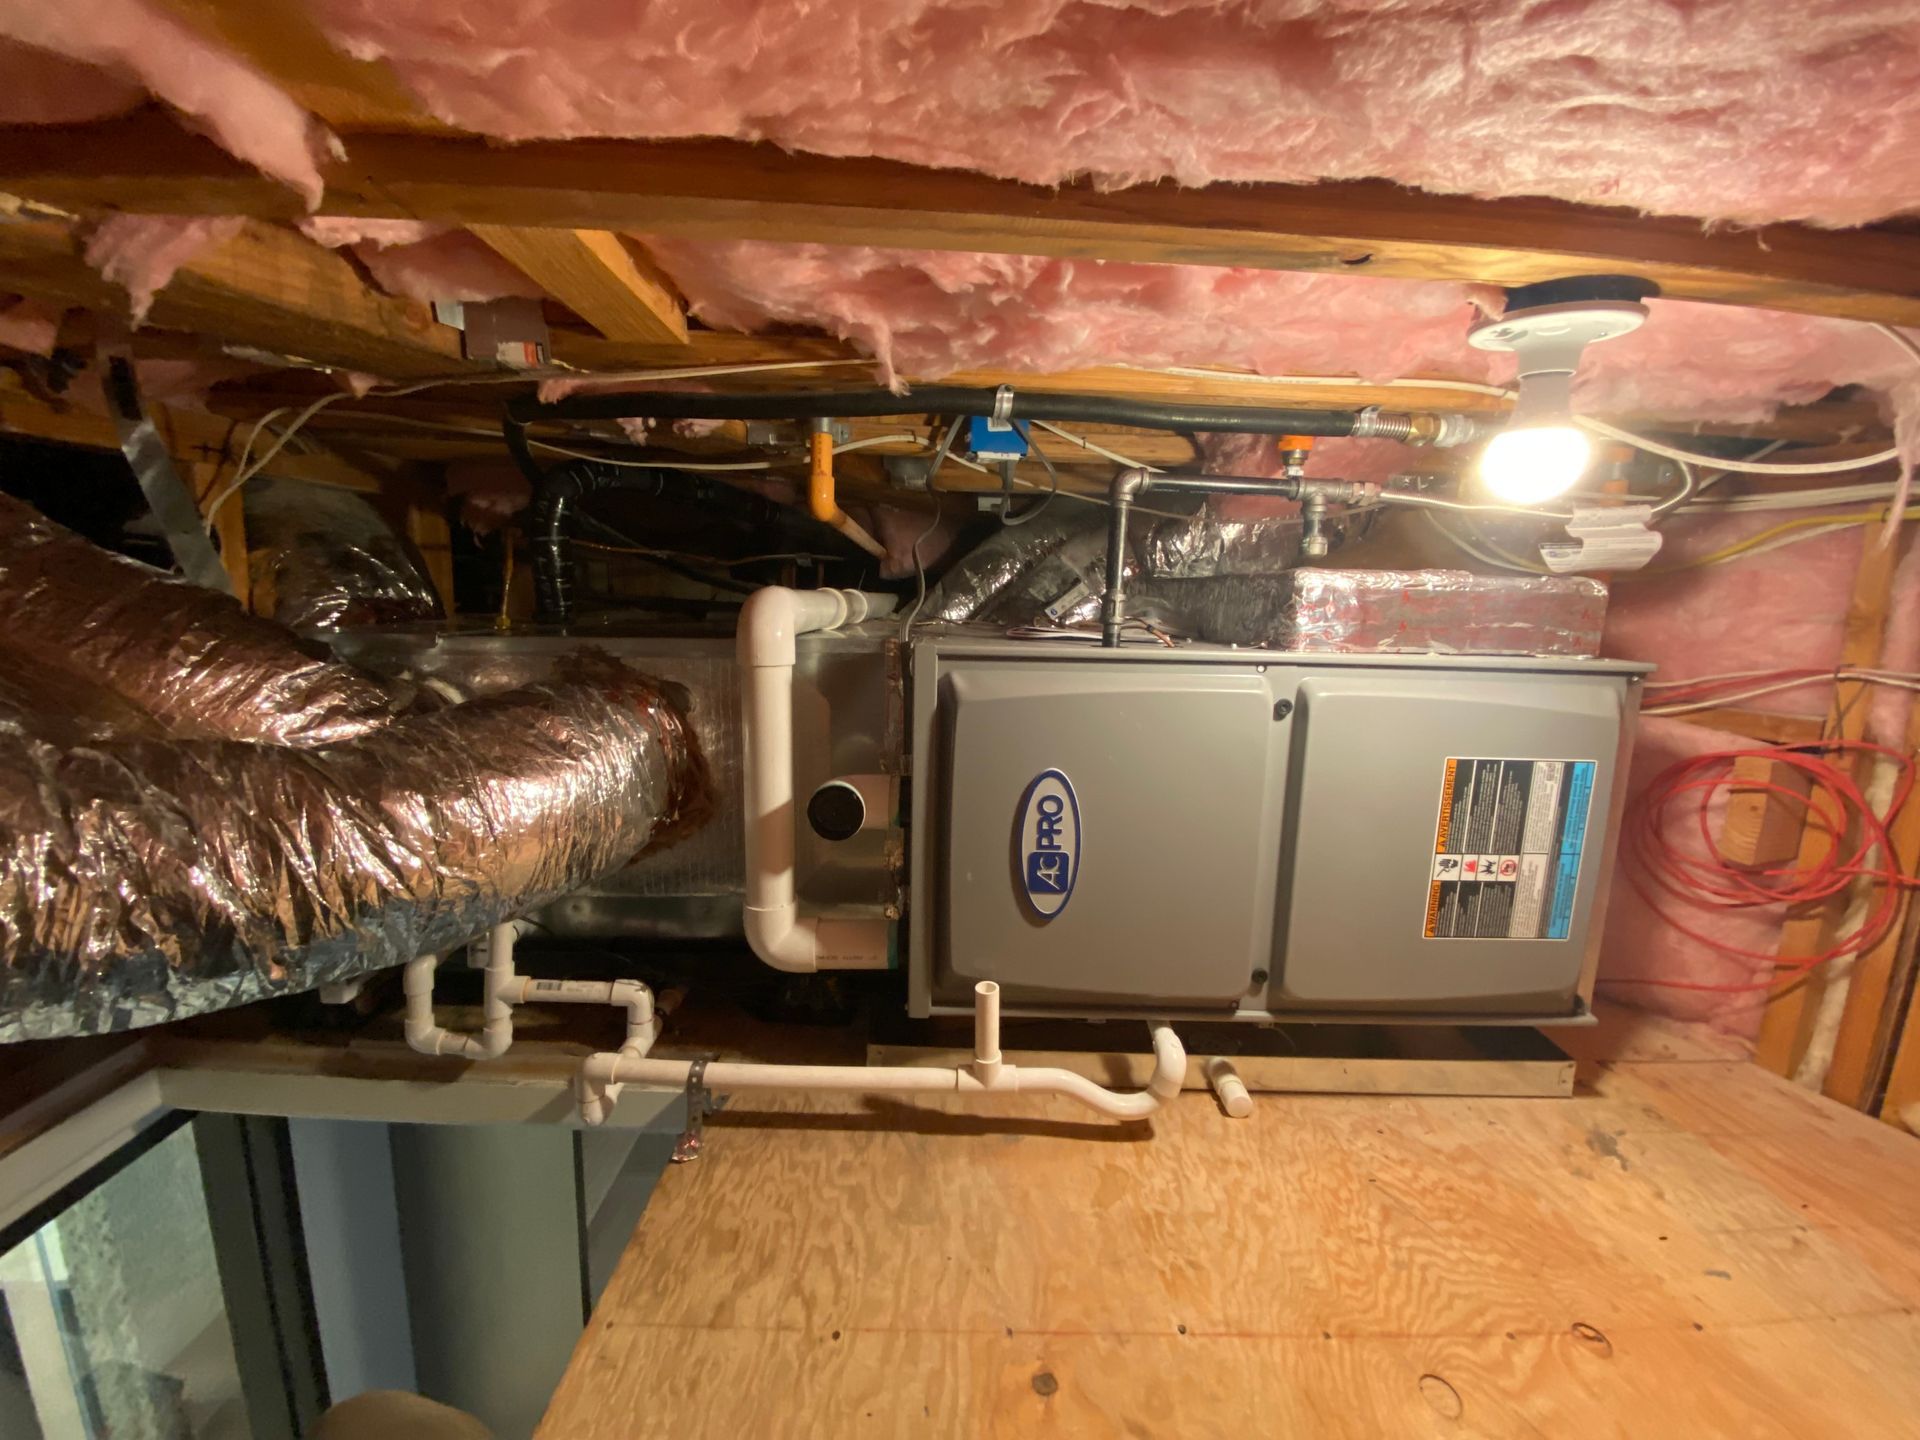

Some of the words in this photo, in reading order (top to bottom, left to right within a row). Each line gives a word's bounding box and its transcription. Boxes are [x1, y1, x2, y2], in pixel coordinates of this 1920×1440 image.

[1036, 794, 1064, 851] PRO
[1440, 765, 1456, 839] AVERTISSEMENT
[1037, 857, 1061, 890] AC
[1428, 884, 1440, 925] WARNING
